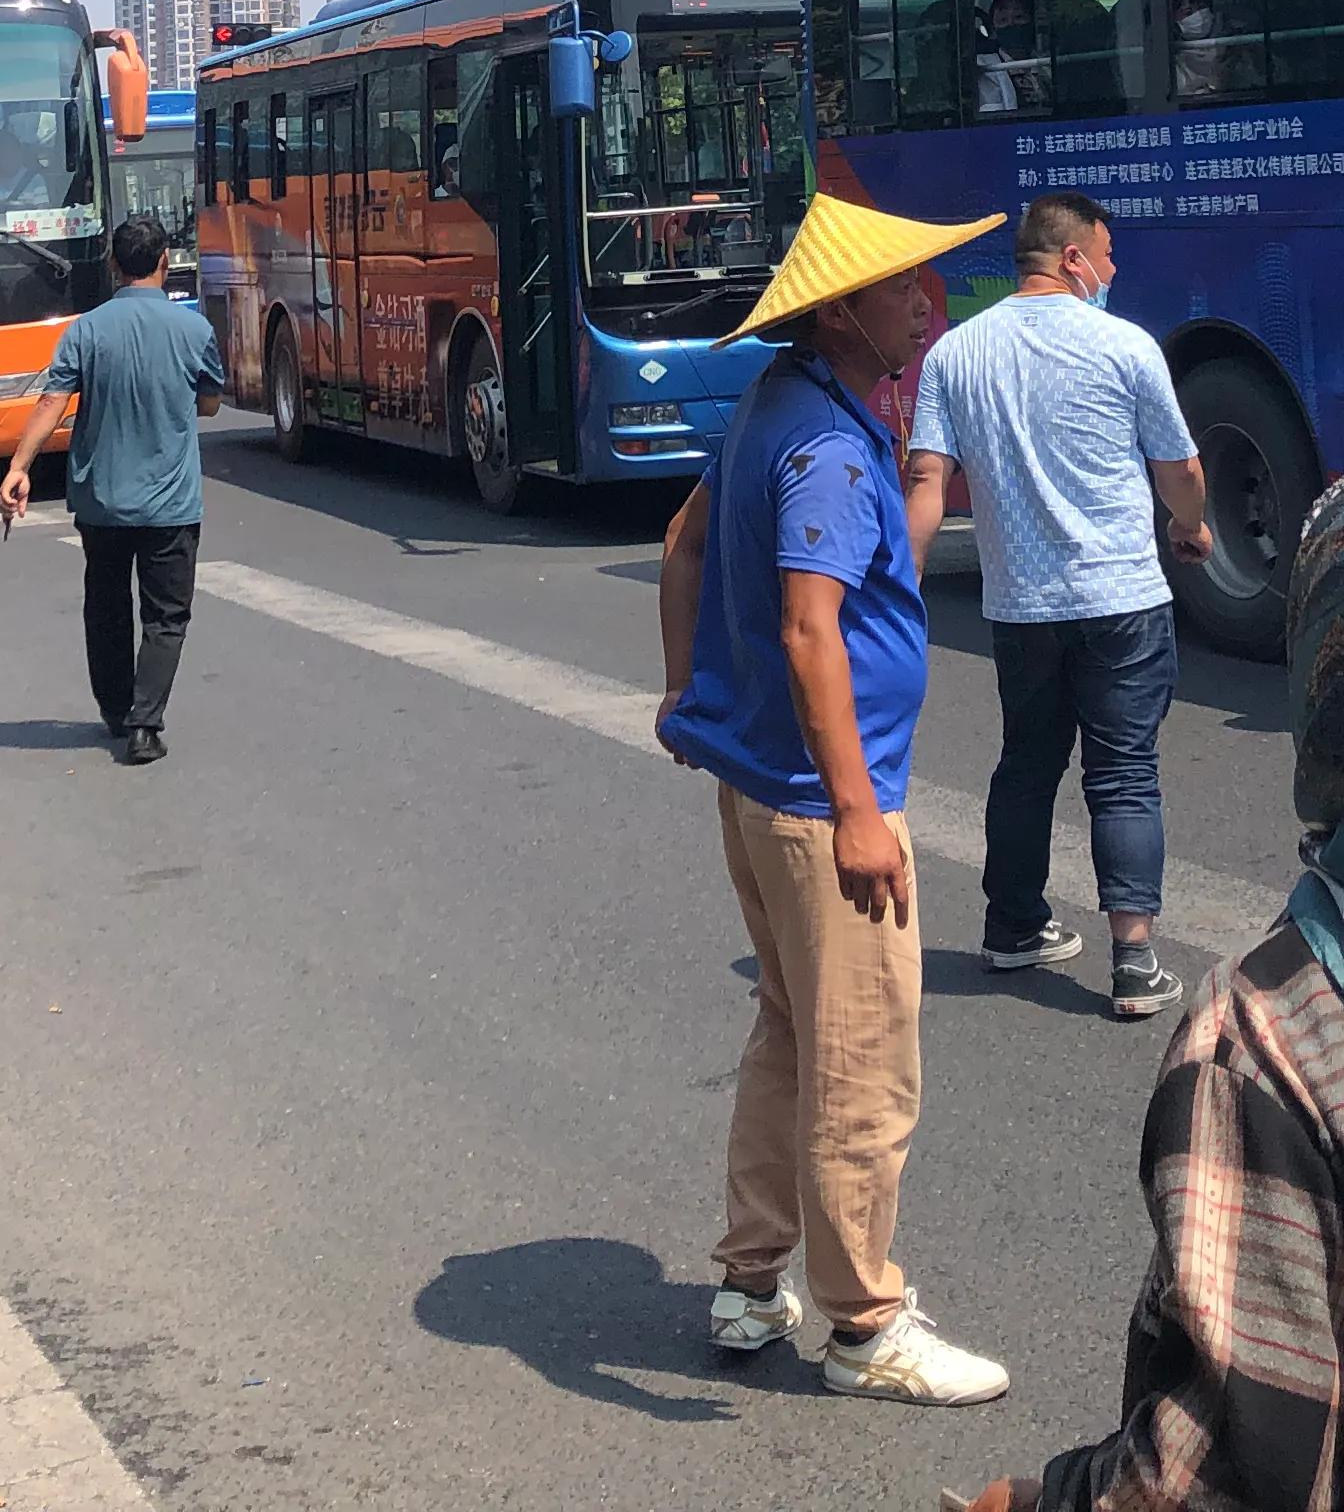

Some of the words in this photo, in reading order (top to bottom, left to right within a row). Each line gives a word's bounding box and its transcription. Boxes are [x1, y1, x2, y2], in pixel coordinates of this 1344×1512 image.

[1182, 116, 1304, 145] 连云港市房地产业协会
